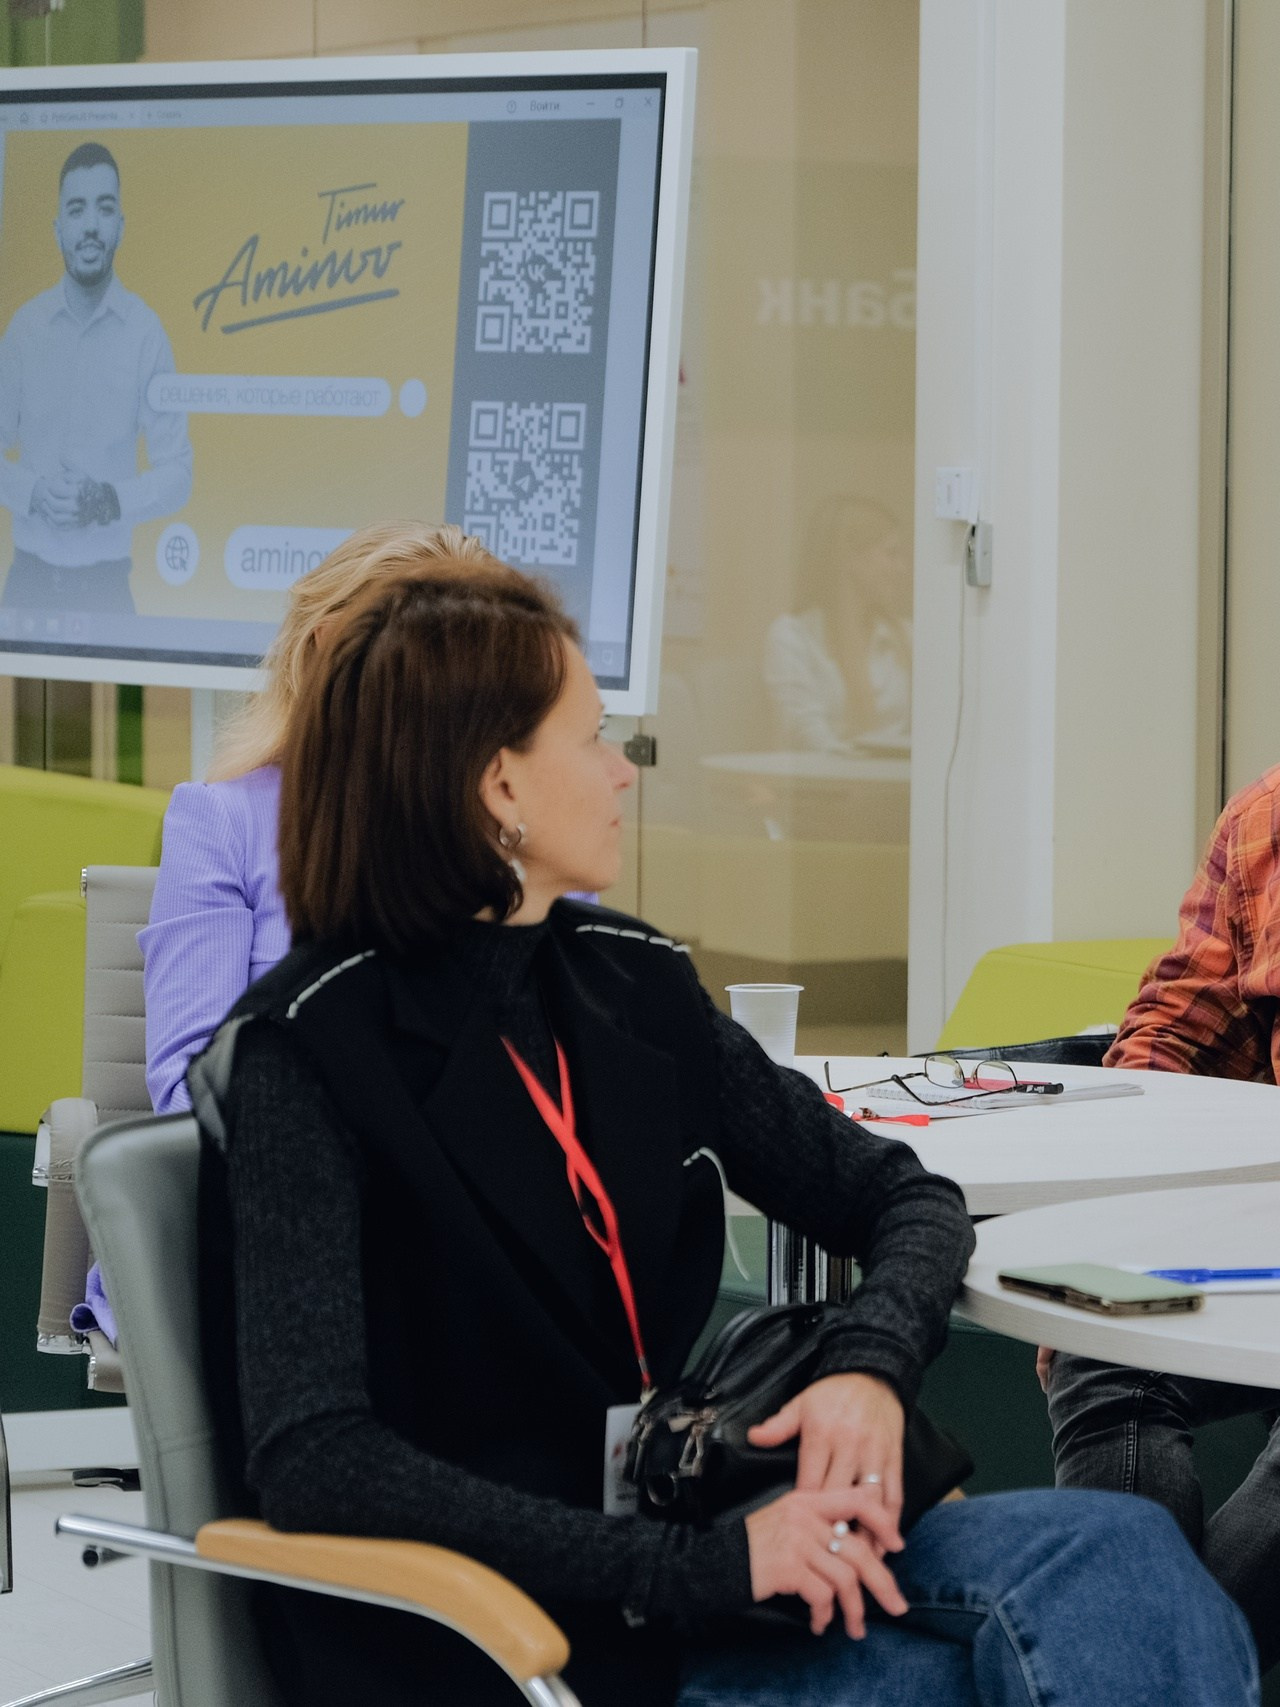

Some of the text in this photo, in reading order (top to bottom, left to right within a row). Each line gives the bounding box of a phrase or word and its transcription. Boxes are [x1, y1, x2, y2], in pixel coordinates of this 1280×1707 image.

[529, 100, 561, 113] Войти
[317, 181, 405, 246] Timur
[192, 233, 403, 333] Aminov
[159, 386, 231, 406] решения,
[305, 385, 382, 409] работают
[240, 541, 329, 575] amino
